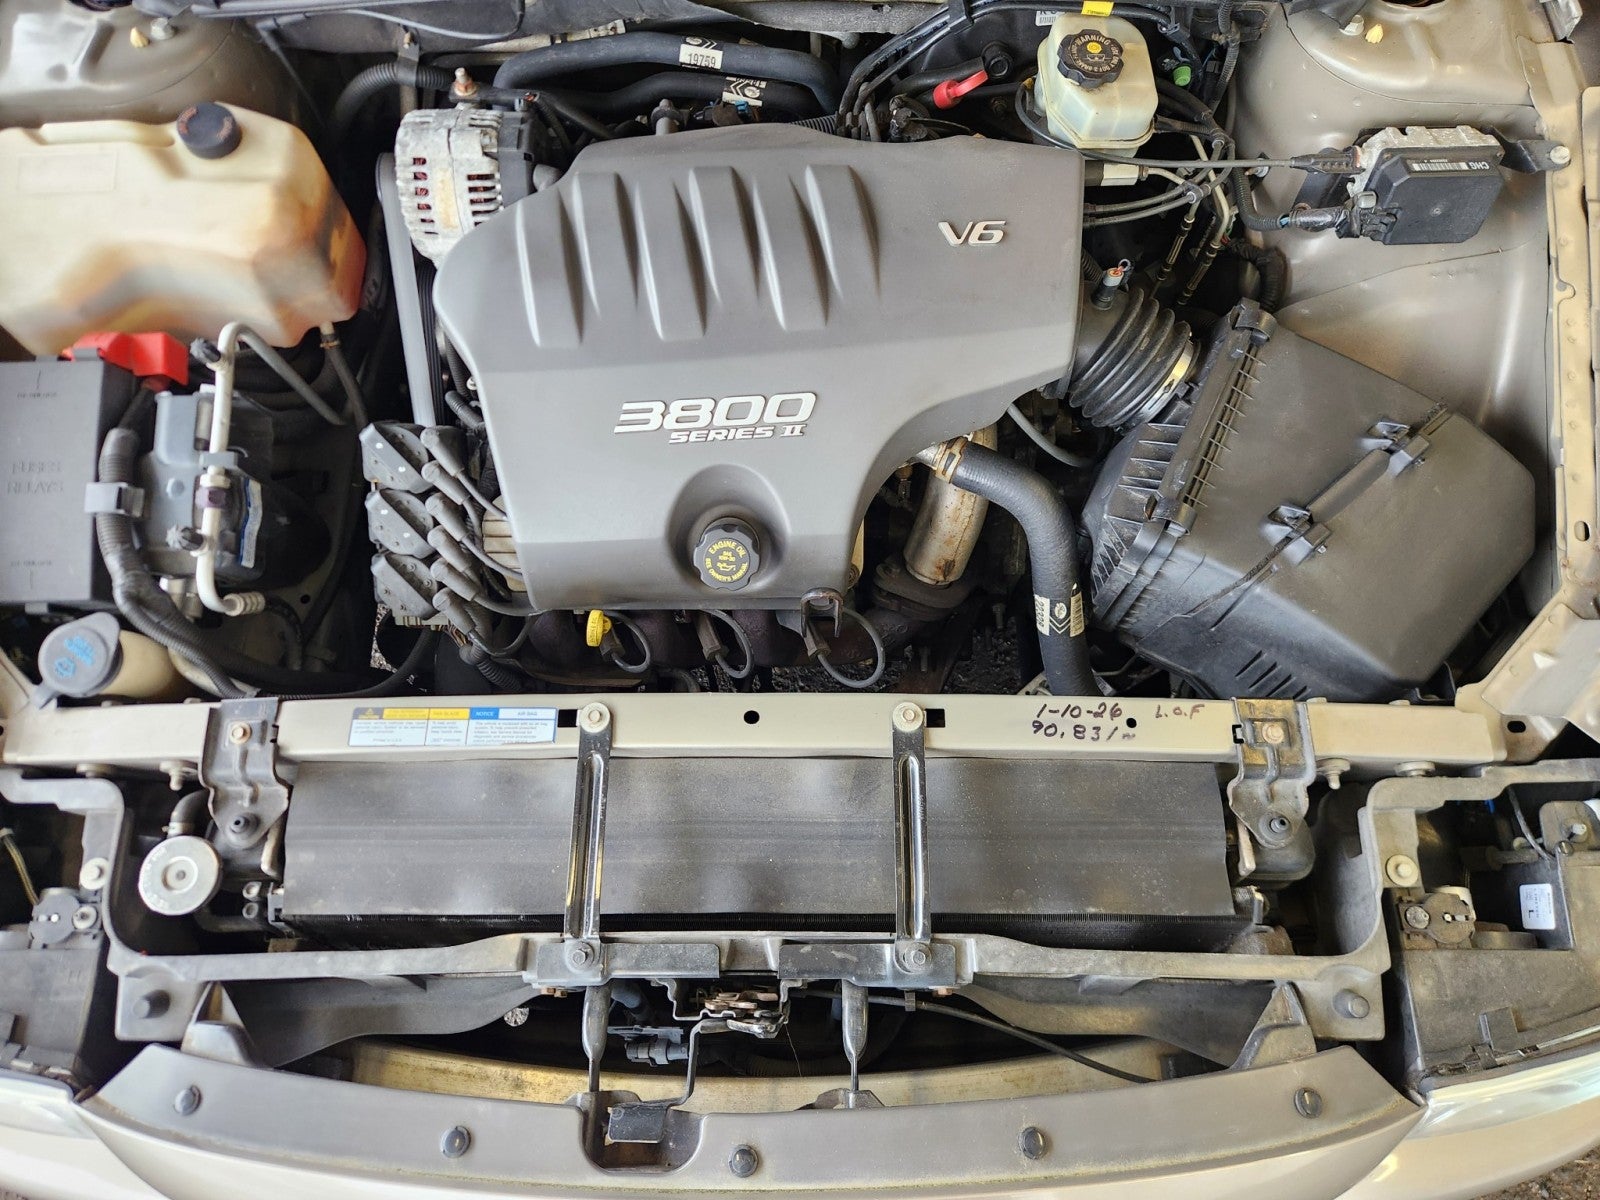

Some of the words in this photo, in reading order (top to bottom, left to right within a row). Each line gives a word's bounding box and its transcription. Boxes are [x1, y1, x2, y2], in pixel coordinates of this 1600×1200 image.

[1076, 34, 1111, 46] WARNING
[688, 53, 717, 68] 19759
[938, 220, 1006, 246] V6
[614, 392, 817, 434] 3800
[669, 426, 775, 444] SERIES
[780, 424, 807, 437] II
[708, 540, 737, 555] ENGINE
[735, 545, 747, 558] OIL
[1036, 702, 1123, 720] 1-10-26
